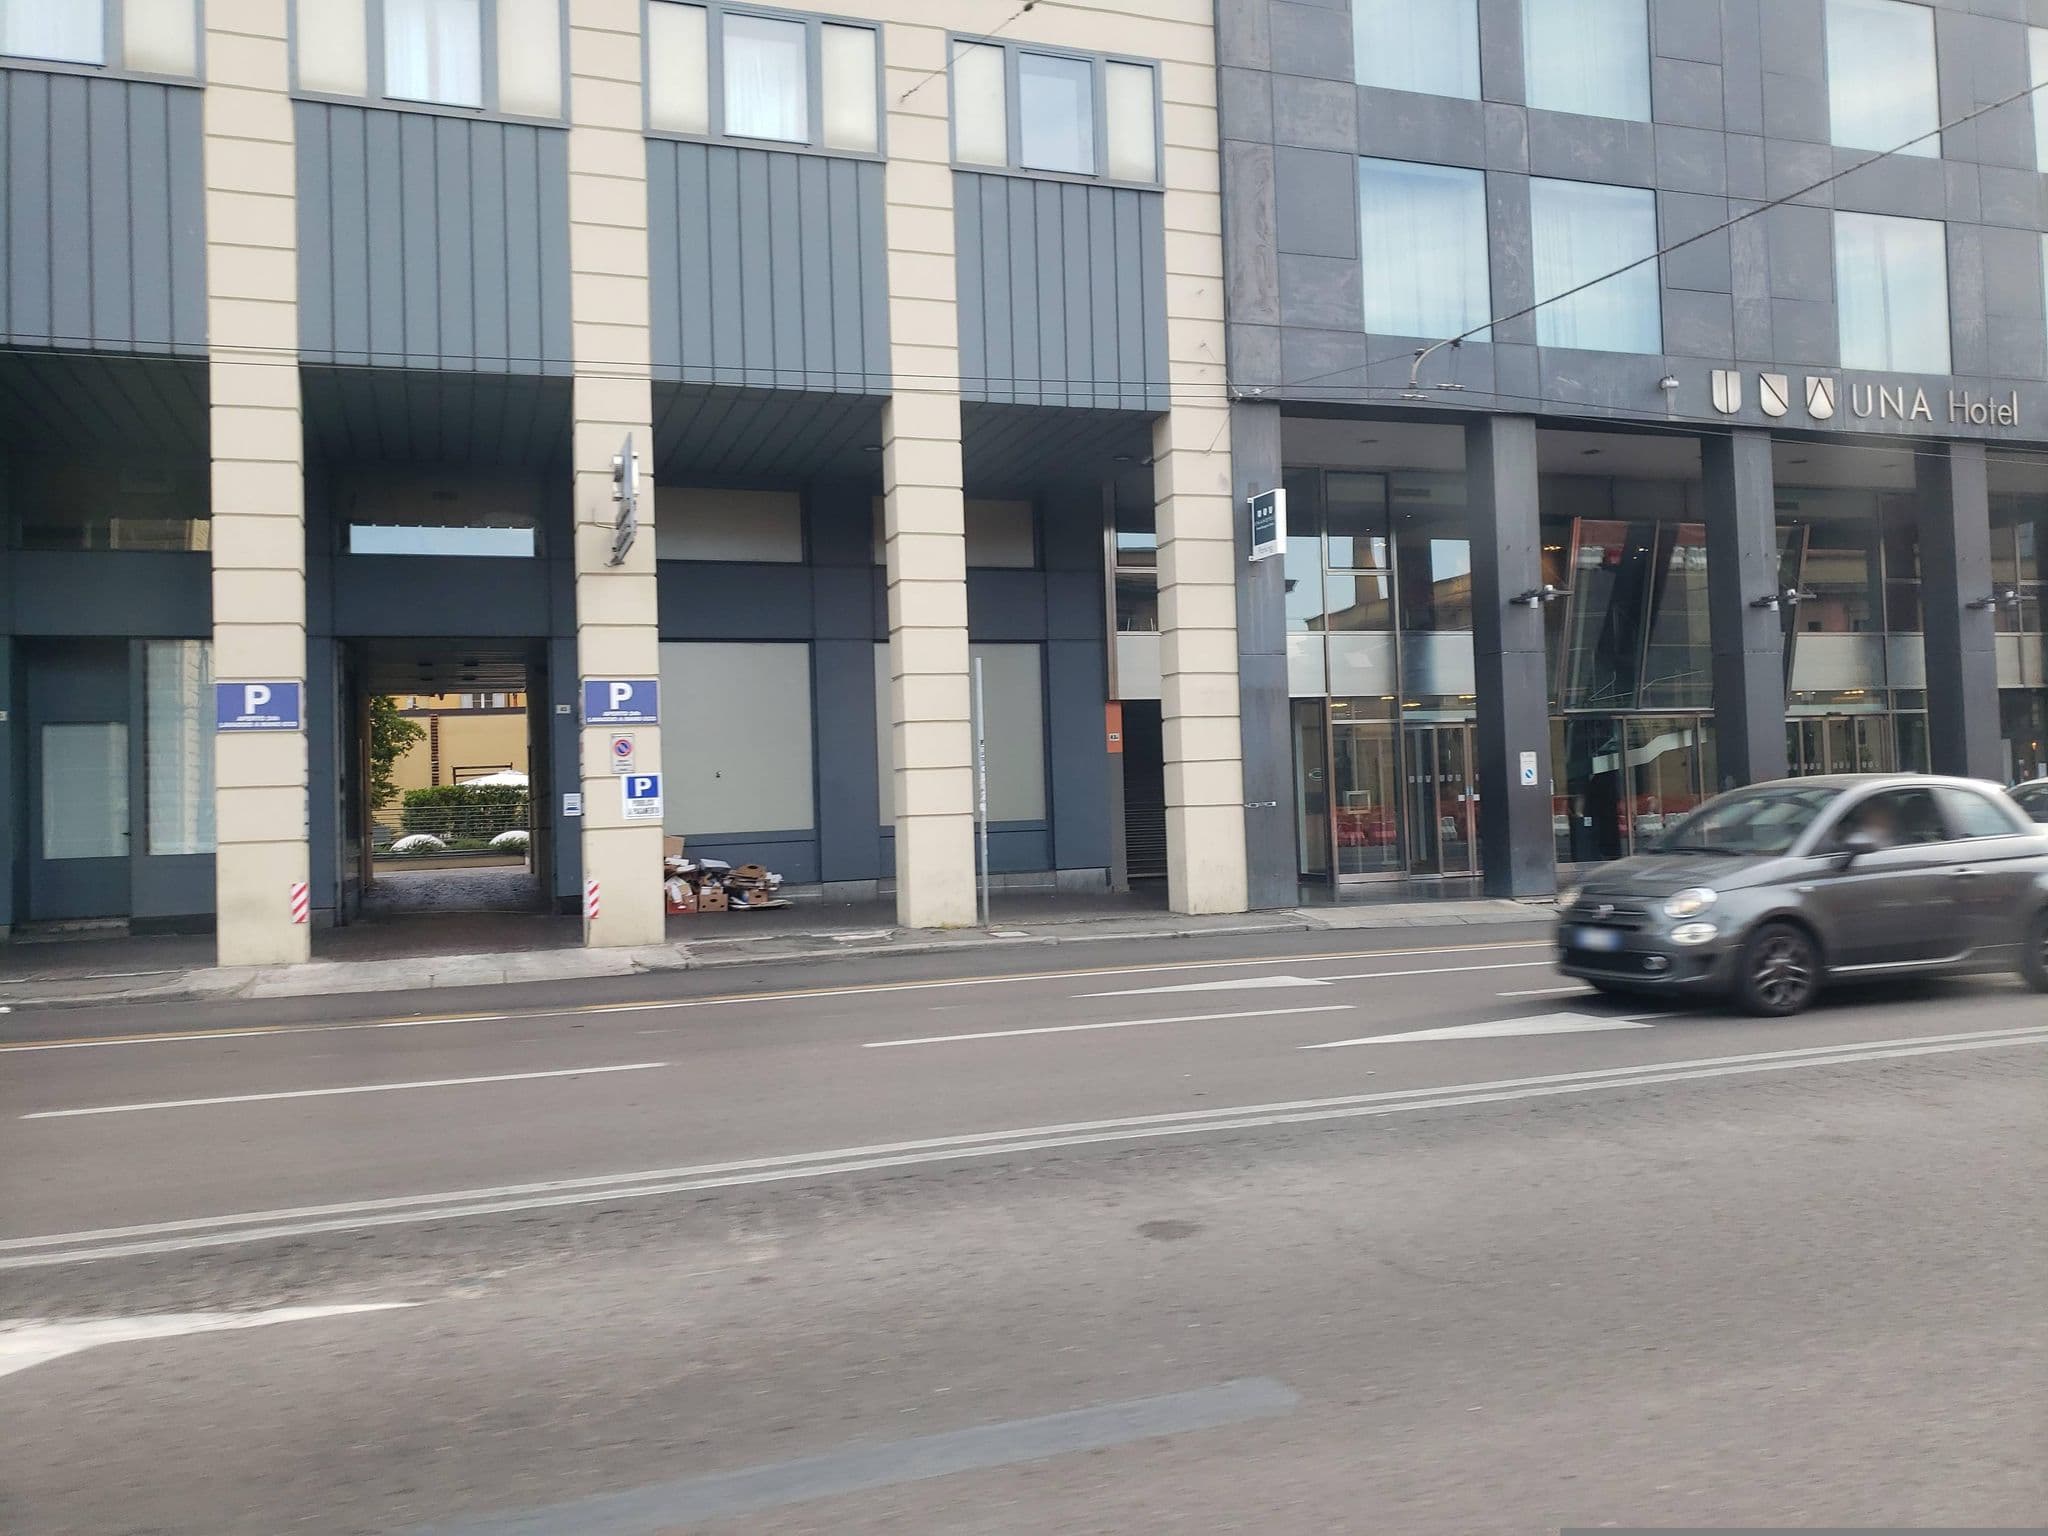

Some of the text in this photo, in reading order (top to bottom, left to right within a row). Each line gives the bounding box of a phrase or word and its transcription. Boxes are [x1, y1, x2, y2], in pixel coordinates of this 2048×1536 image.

[1852, 383, 1934, 422] UNA
[1949, 389, 2018, 426] Hotel
[244, 684, 271, 715] P
[608, 682, 633, 710] P
[634, 777, 652, 797] P
